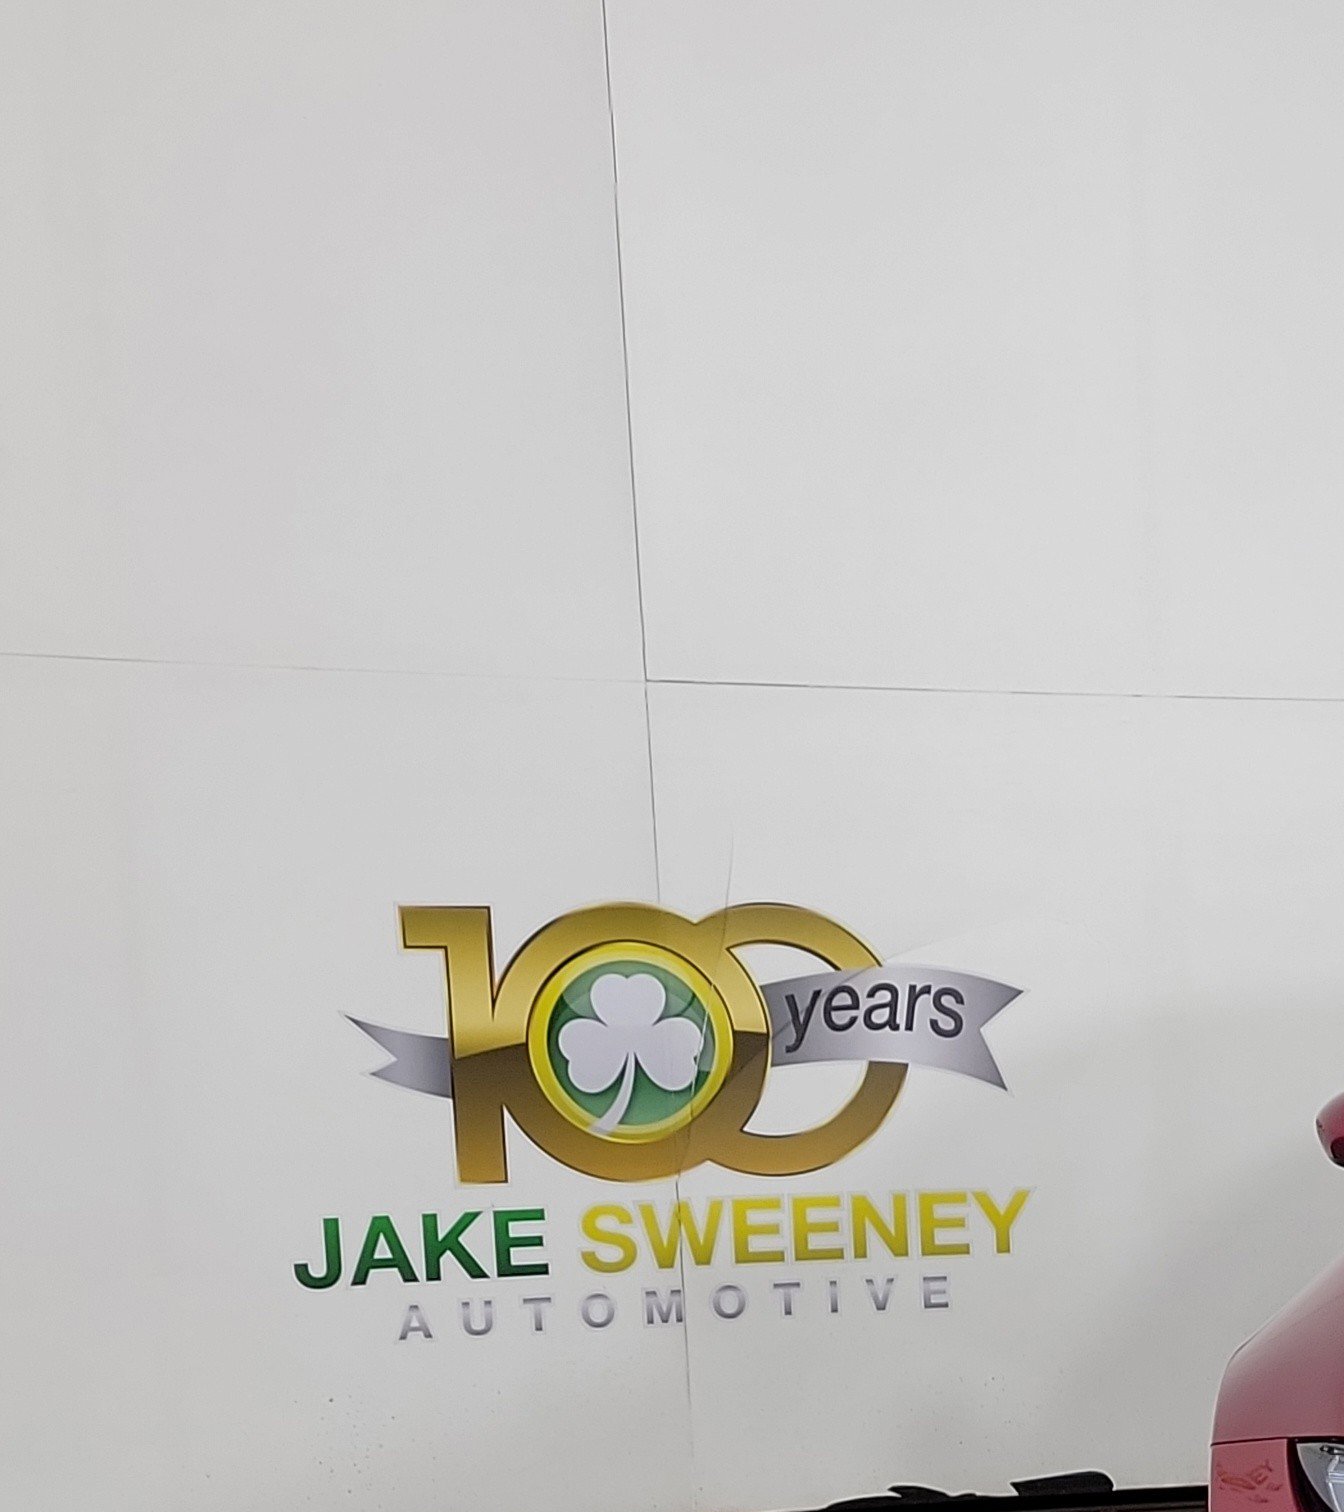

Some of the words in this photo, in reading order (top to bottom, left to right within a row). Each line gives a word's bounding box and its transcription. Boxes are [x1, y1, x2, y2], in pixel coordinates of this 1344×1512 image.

[784, 981, 965, 1053] years
[293, 1208, 549, 1290] JAKE
[580, 1190, 1030, 1273] SWEENEY
[398, 1275, 950, 1342] AUTOMOTIVE
